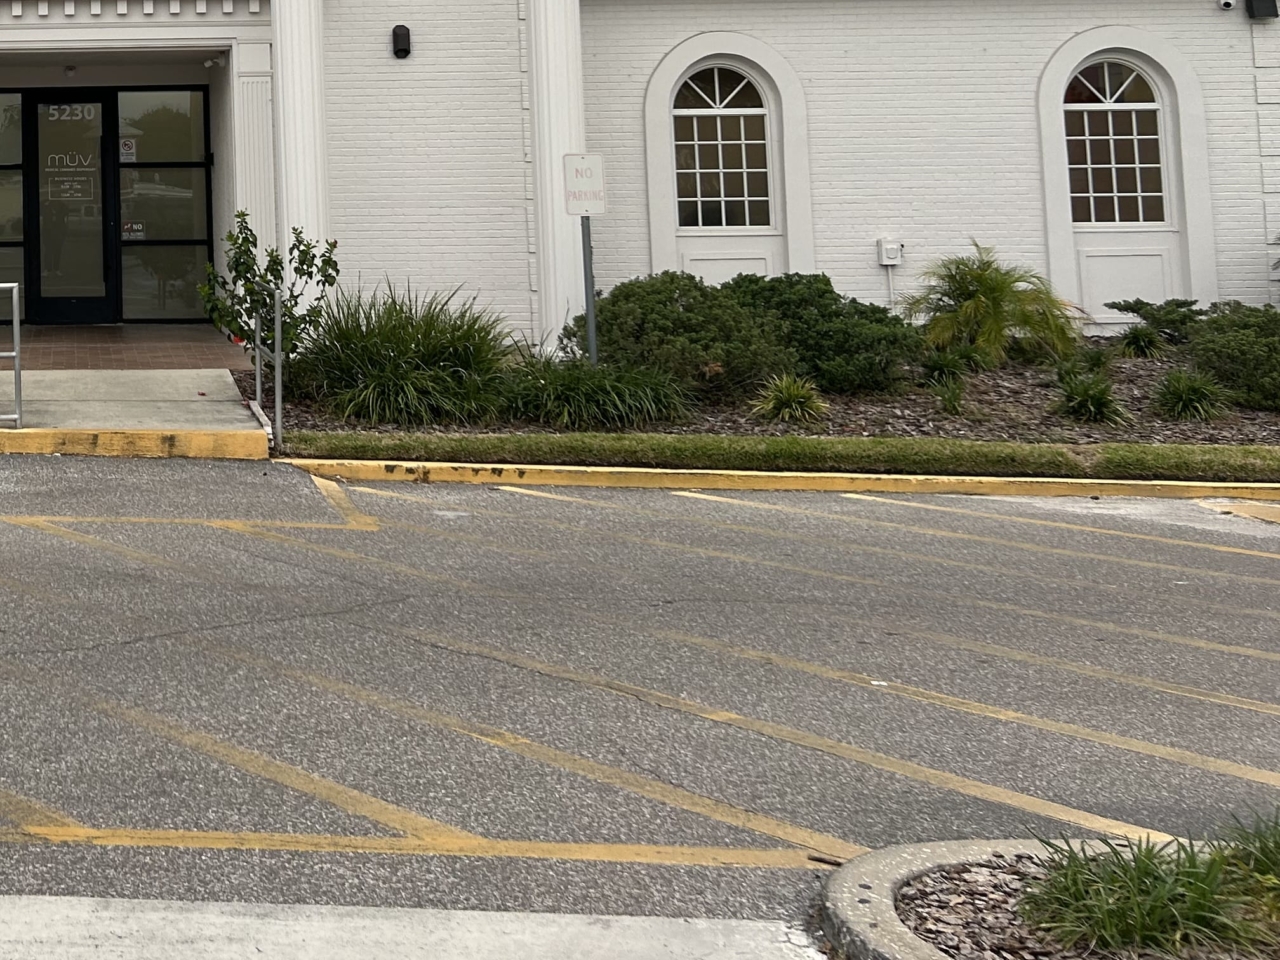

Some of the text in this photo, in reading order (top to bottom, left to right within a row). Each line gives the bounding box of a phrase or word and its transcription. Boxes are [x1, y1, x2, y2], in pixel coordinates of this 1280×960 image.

[48, 105, 95, 120] 5230
[575, 167, 592, 179] NO
[568, 190, 603, 201] PARKING
[132, 223, 143, 231] NO
